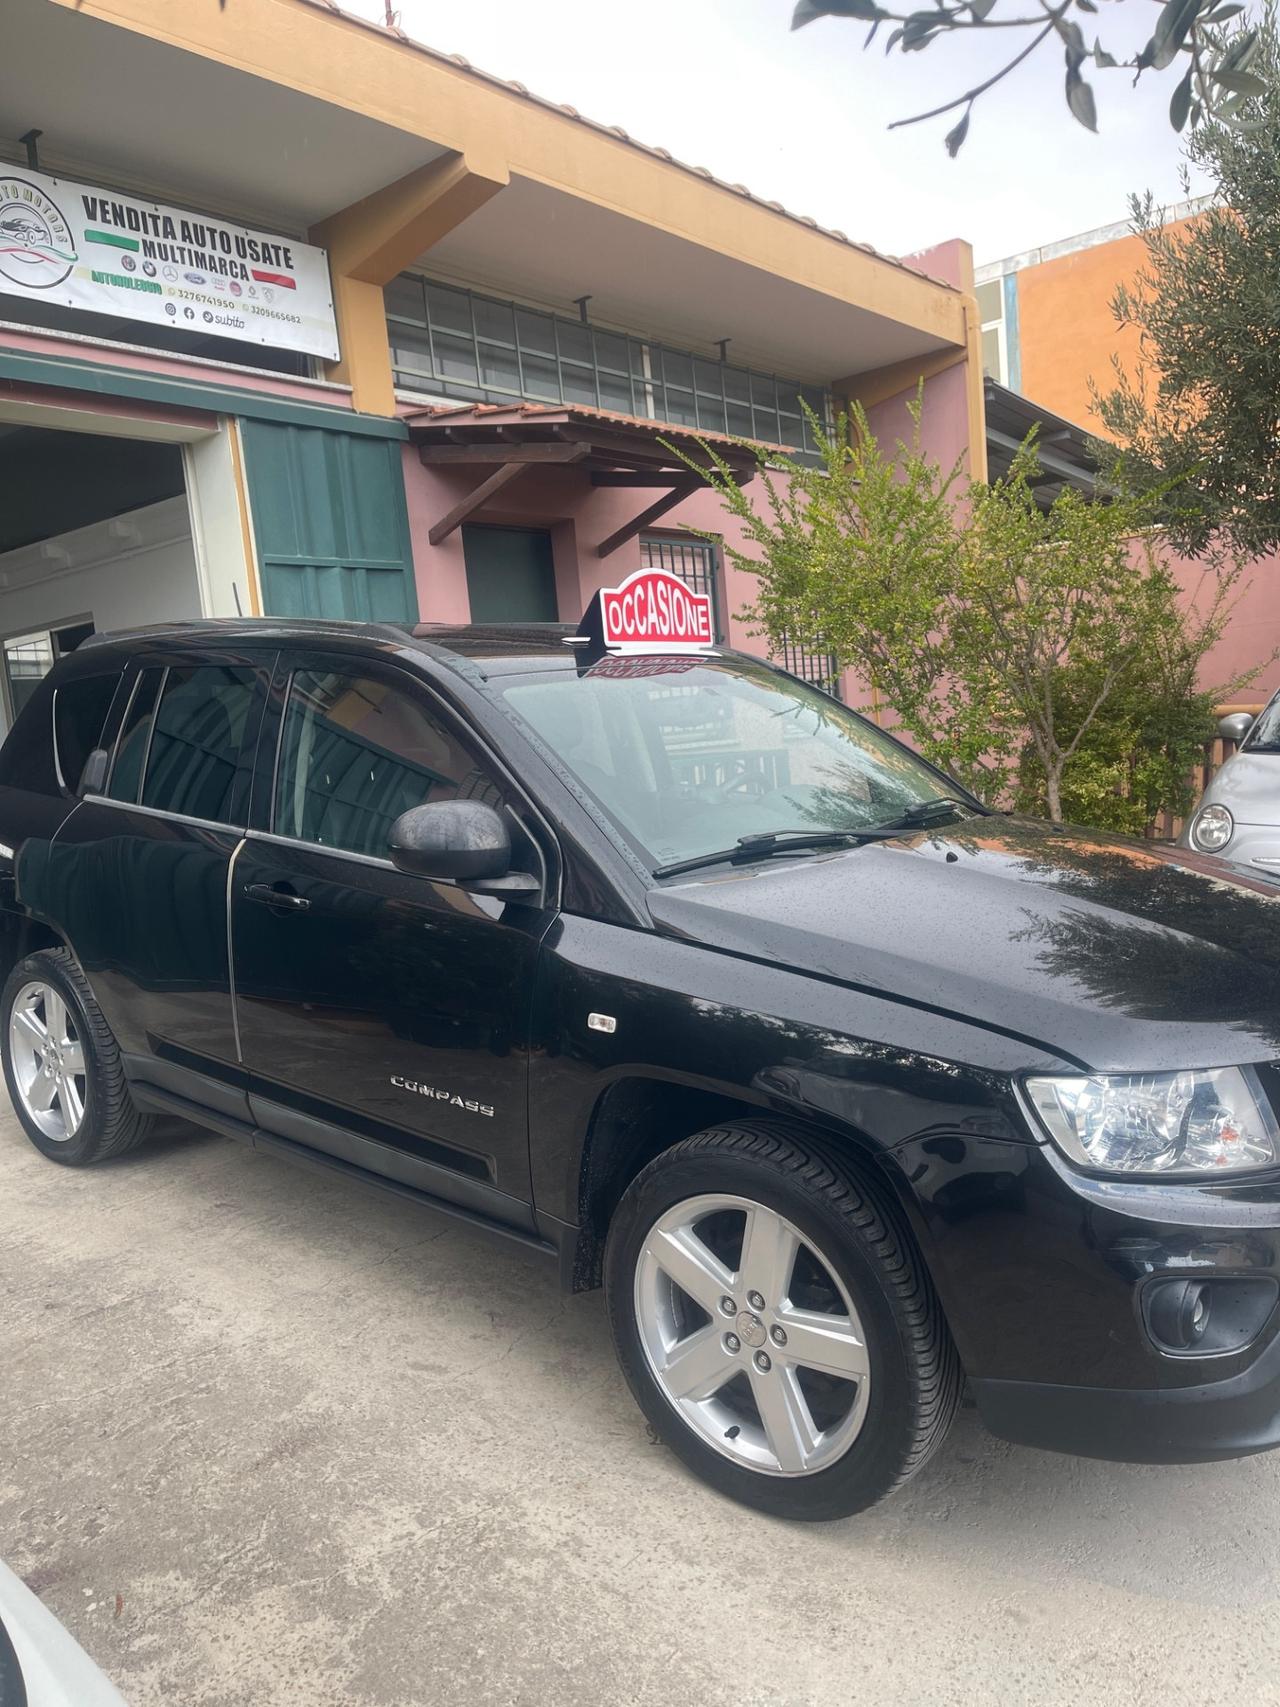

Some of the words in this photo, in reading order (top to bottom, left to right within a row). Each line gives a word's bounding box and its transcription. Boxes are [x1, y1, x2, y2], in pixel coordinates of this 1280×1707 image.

[0, 184, 19, 201] TO
[22, 188, 68, 243] MOTORS
[81, 194, 177, 240] VENDITA
[181, 220, 232, 255] AUTO
[234, 234, 294, 270] USATE
[141, 238, 250, 282] MULTIMARCA
[178, 289, 235, 309] 3276741950
[215, 313, 245, 329] subito
[608, 580, 709, 637] OCCASIONE
[390, 1074, 494, 1117] COMPASS
